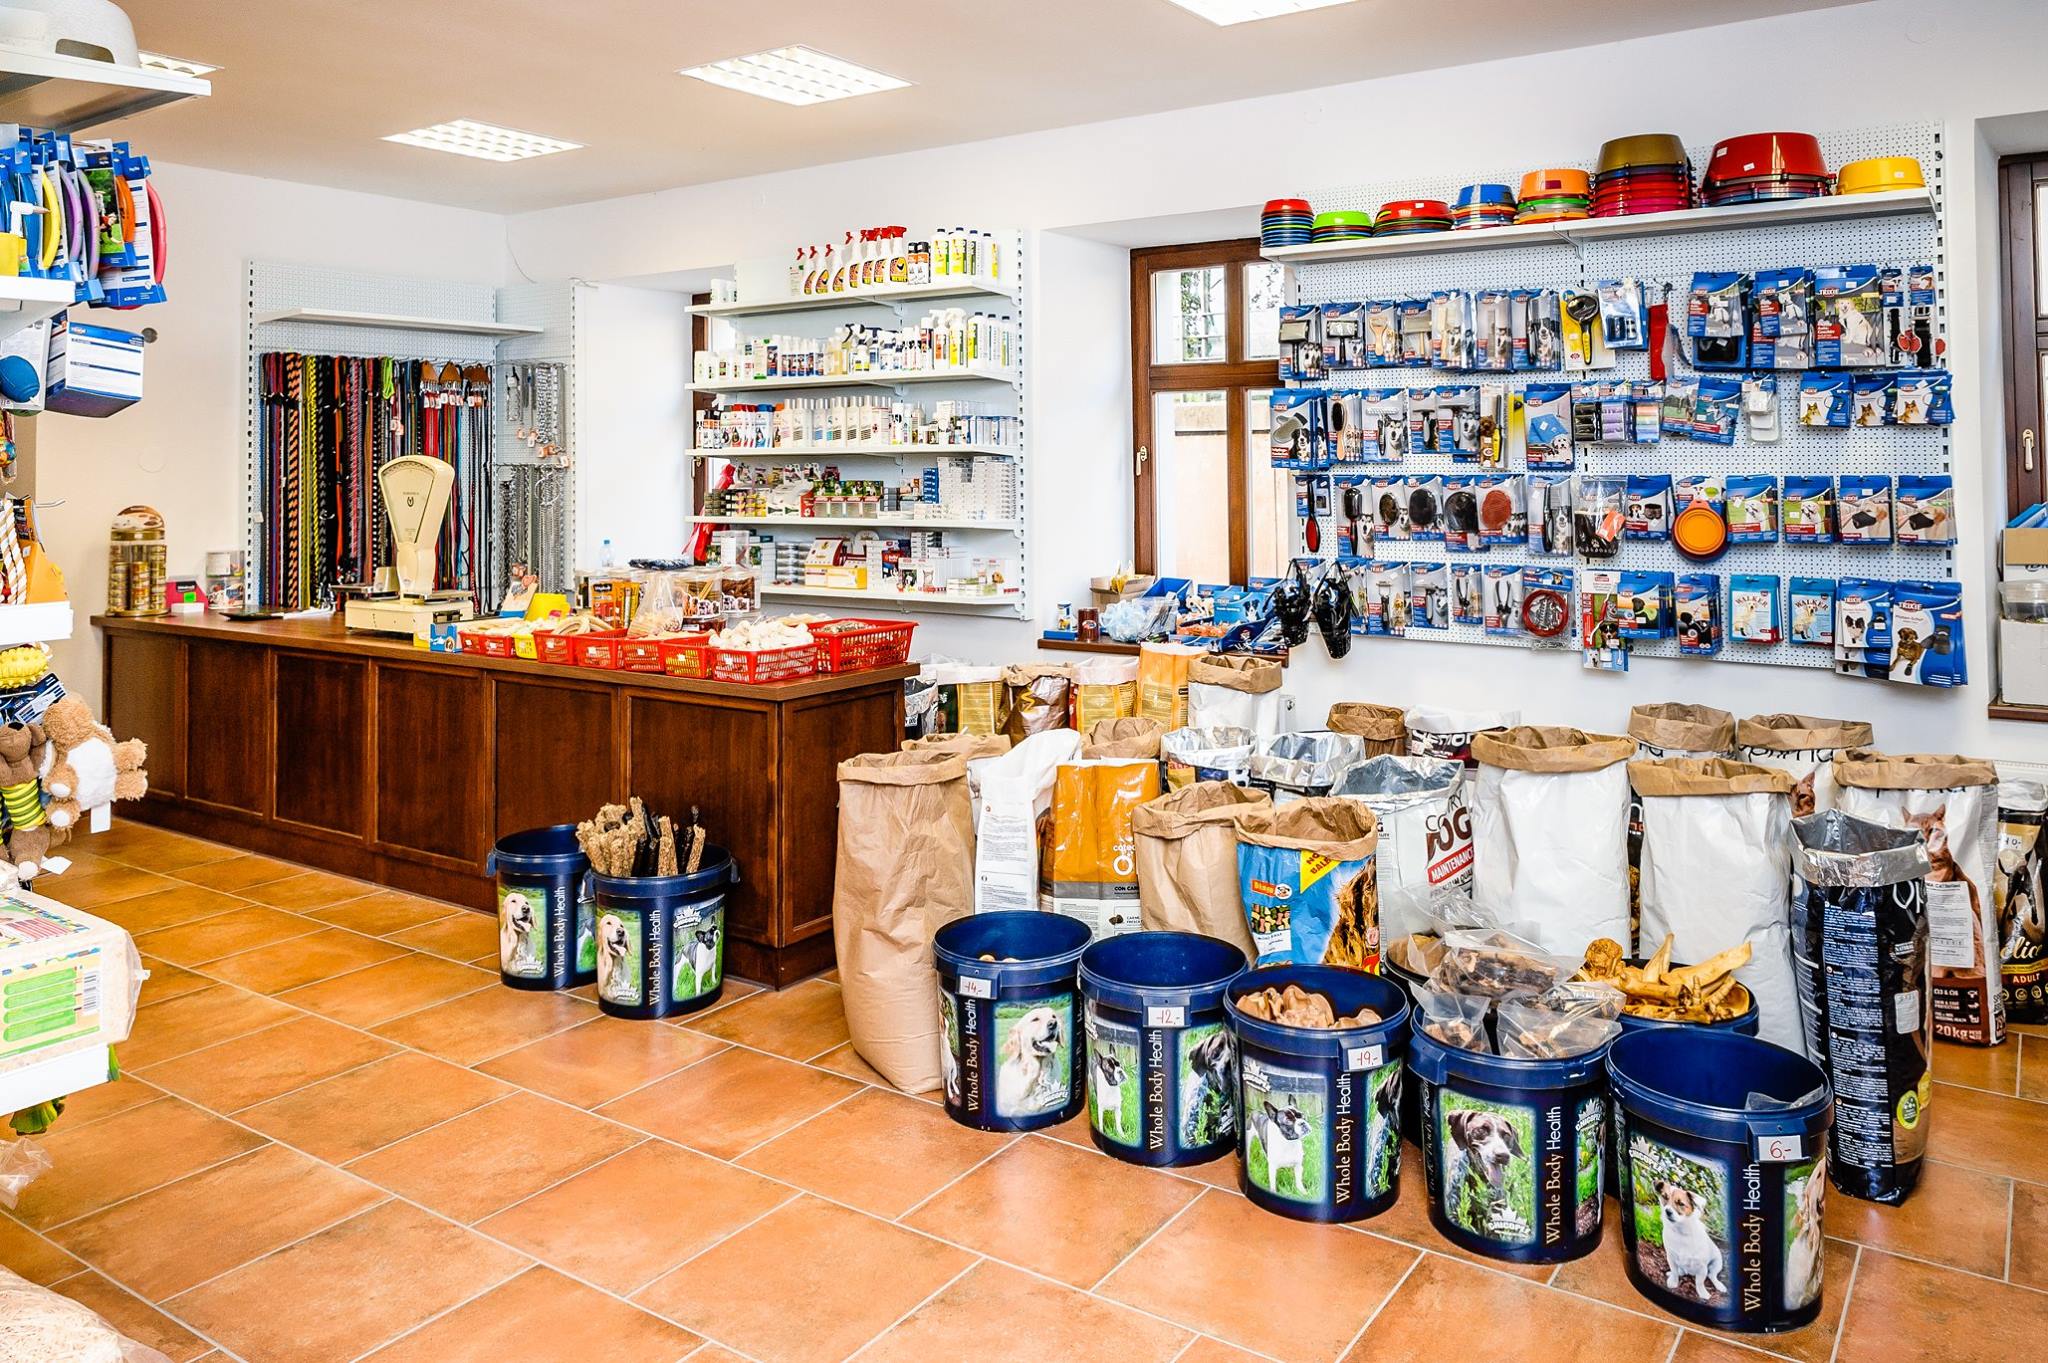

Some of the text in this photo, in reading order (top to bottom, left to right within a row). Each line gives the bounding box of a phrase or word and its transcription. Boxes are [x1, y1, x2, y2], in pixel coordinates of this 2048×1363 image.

[552, 886, 568, 978] Whole Body Health
[648, 909, 663, 1007] Whole Body Health
[2012, 973, 2041, 984] ADULT
[963, 999, 980, 1112] Whole Body Health
[1148, 1029, 1165, 1150] Whole Body Health
[1336, 1073, 1353, 1205] Whole Body Health
[1546, 1105, 1564, 1246] Whole Body Health
[1743, 1162, 1766, 1313] Whole Body Health
